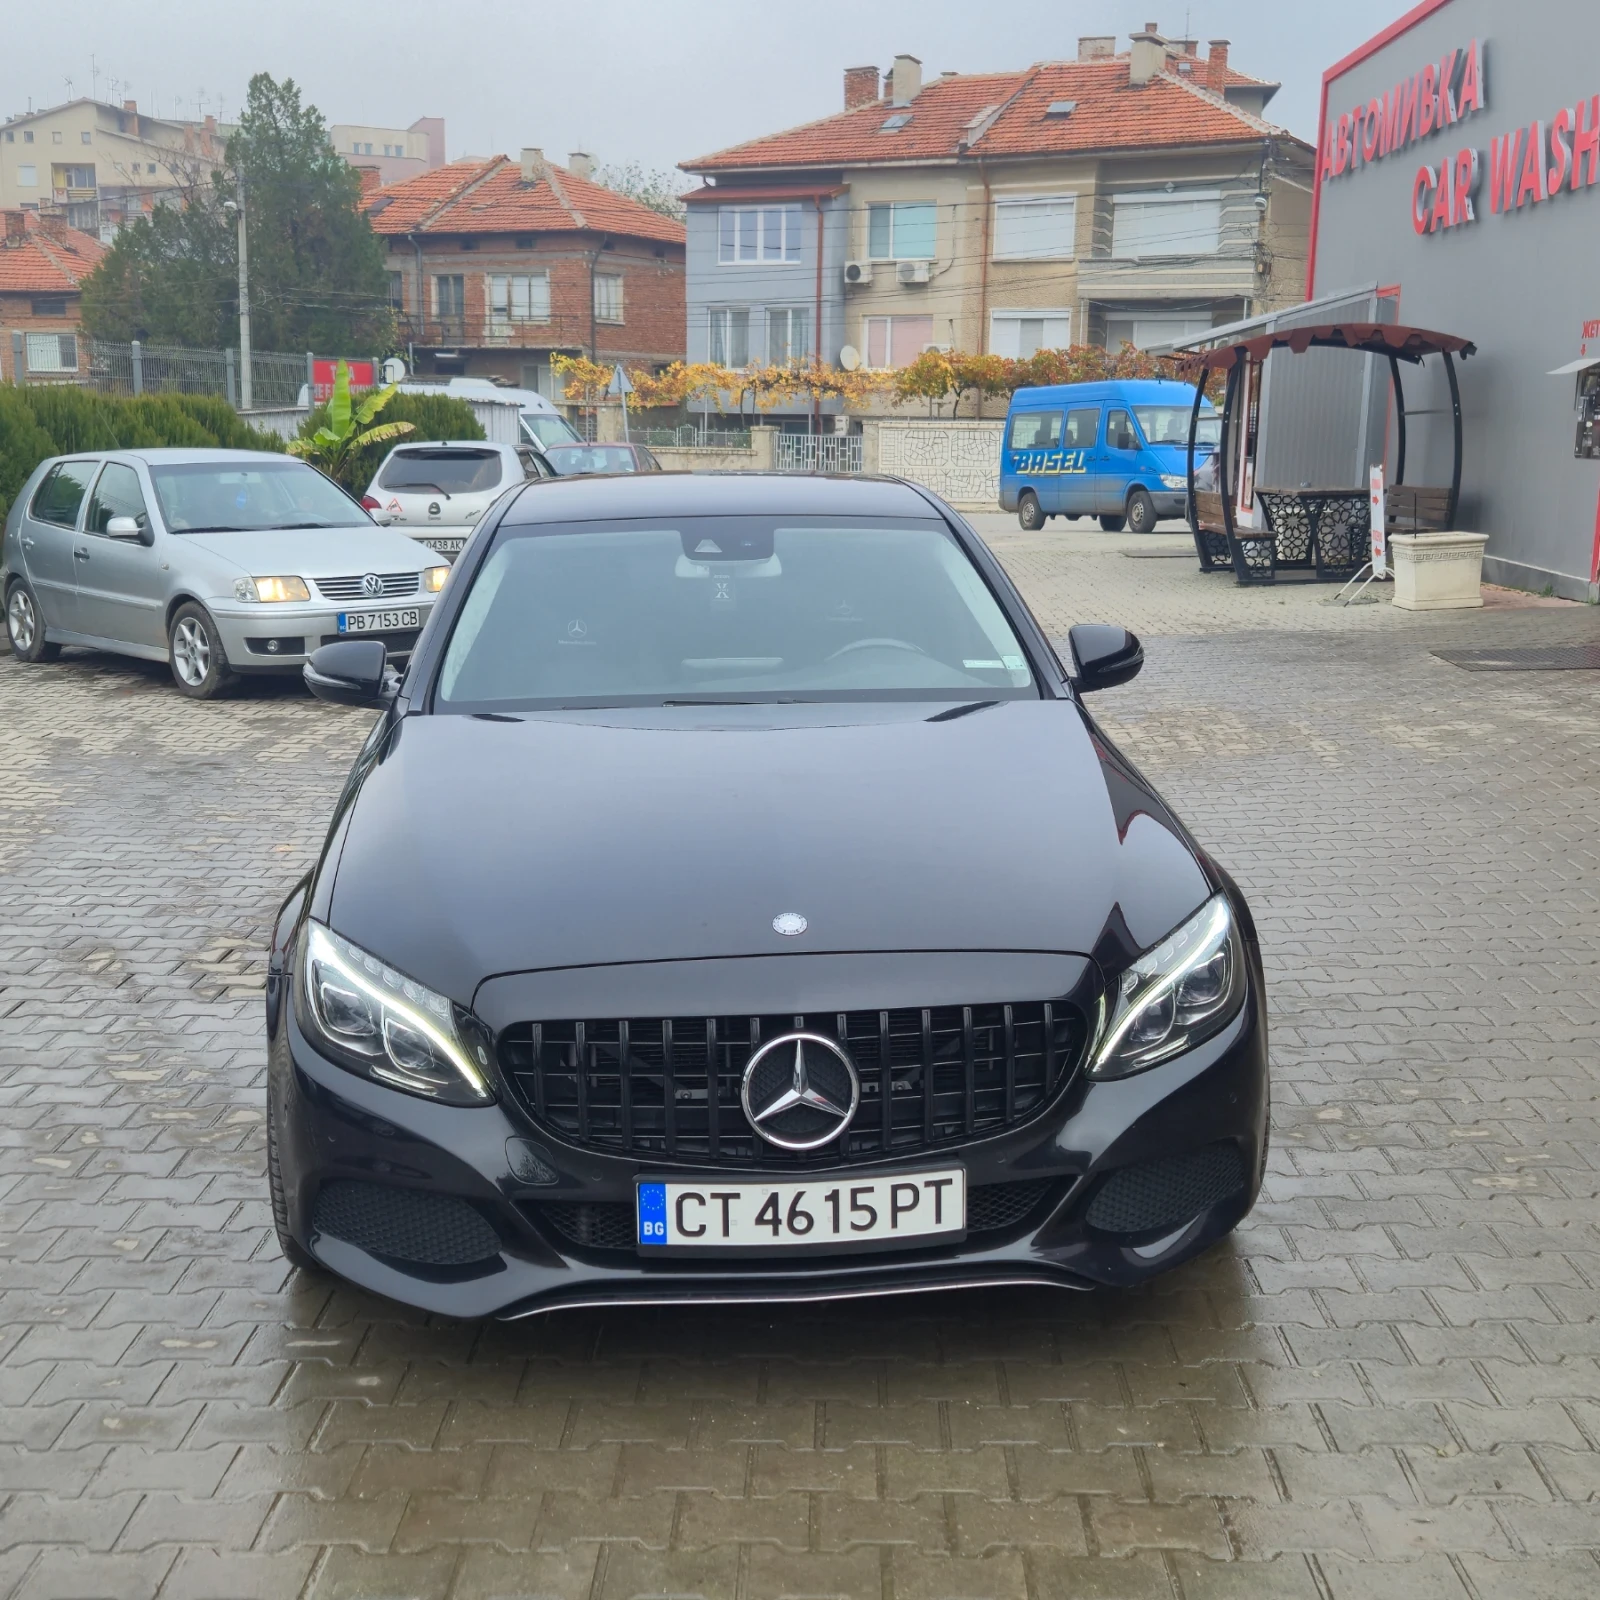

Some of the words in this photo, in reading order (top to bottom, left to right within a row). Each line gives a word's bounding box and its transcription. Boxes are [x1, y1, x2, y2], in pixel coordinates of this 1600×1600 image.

[1320, 38, 1484, 182] АВТОМИВКА
[1412, 148, 1479, 235] CAR
[1490, 94, 1600, 214] WASH
[1014, 450, 1087, 474] BASEL
[426, 541, 448, 550] 0438
[348, 615, 366, 630] PB
[368, 613, 399, 629] 7153
[401, 611, 418, 626] CB
[643, 1221, 664, 1236] BG
[675, 1191, 741, 1238] CT
[755, 1188, 878, 1237] 4615
